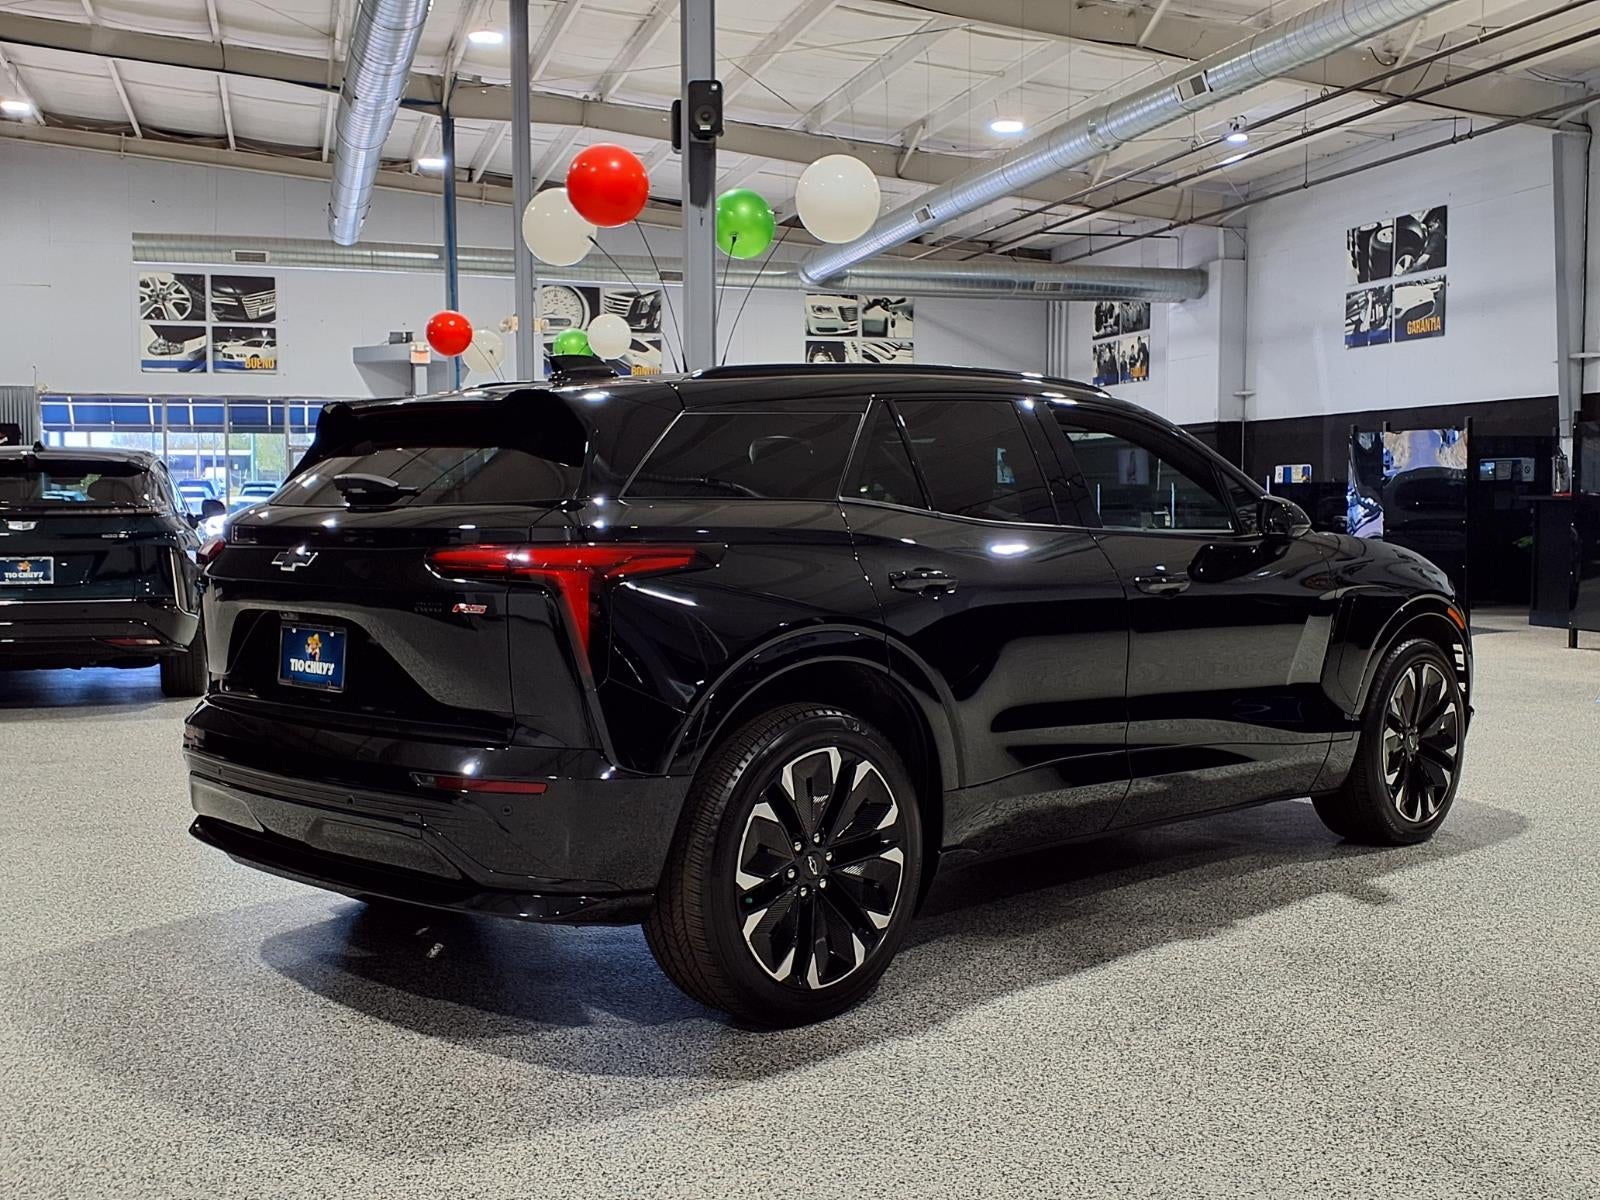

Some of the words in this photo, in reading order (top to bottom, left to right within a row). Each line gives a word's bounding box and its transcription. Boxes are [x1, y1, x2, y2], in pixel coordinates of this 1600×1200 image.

[1407, 316, 1441, 335] GARANTIA
[245, 358, 275, 368] BUENO
[290, 658, 304, 672] TIO
